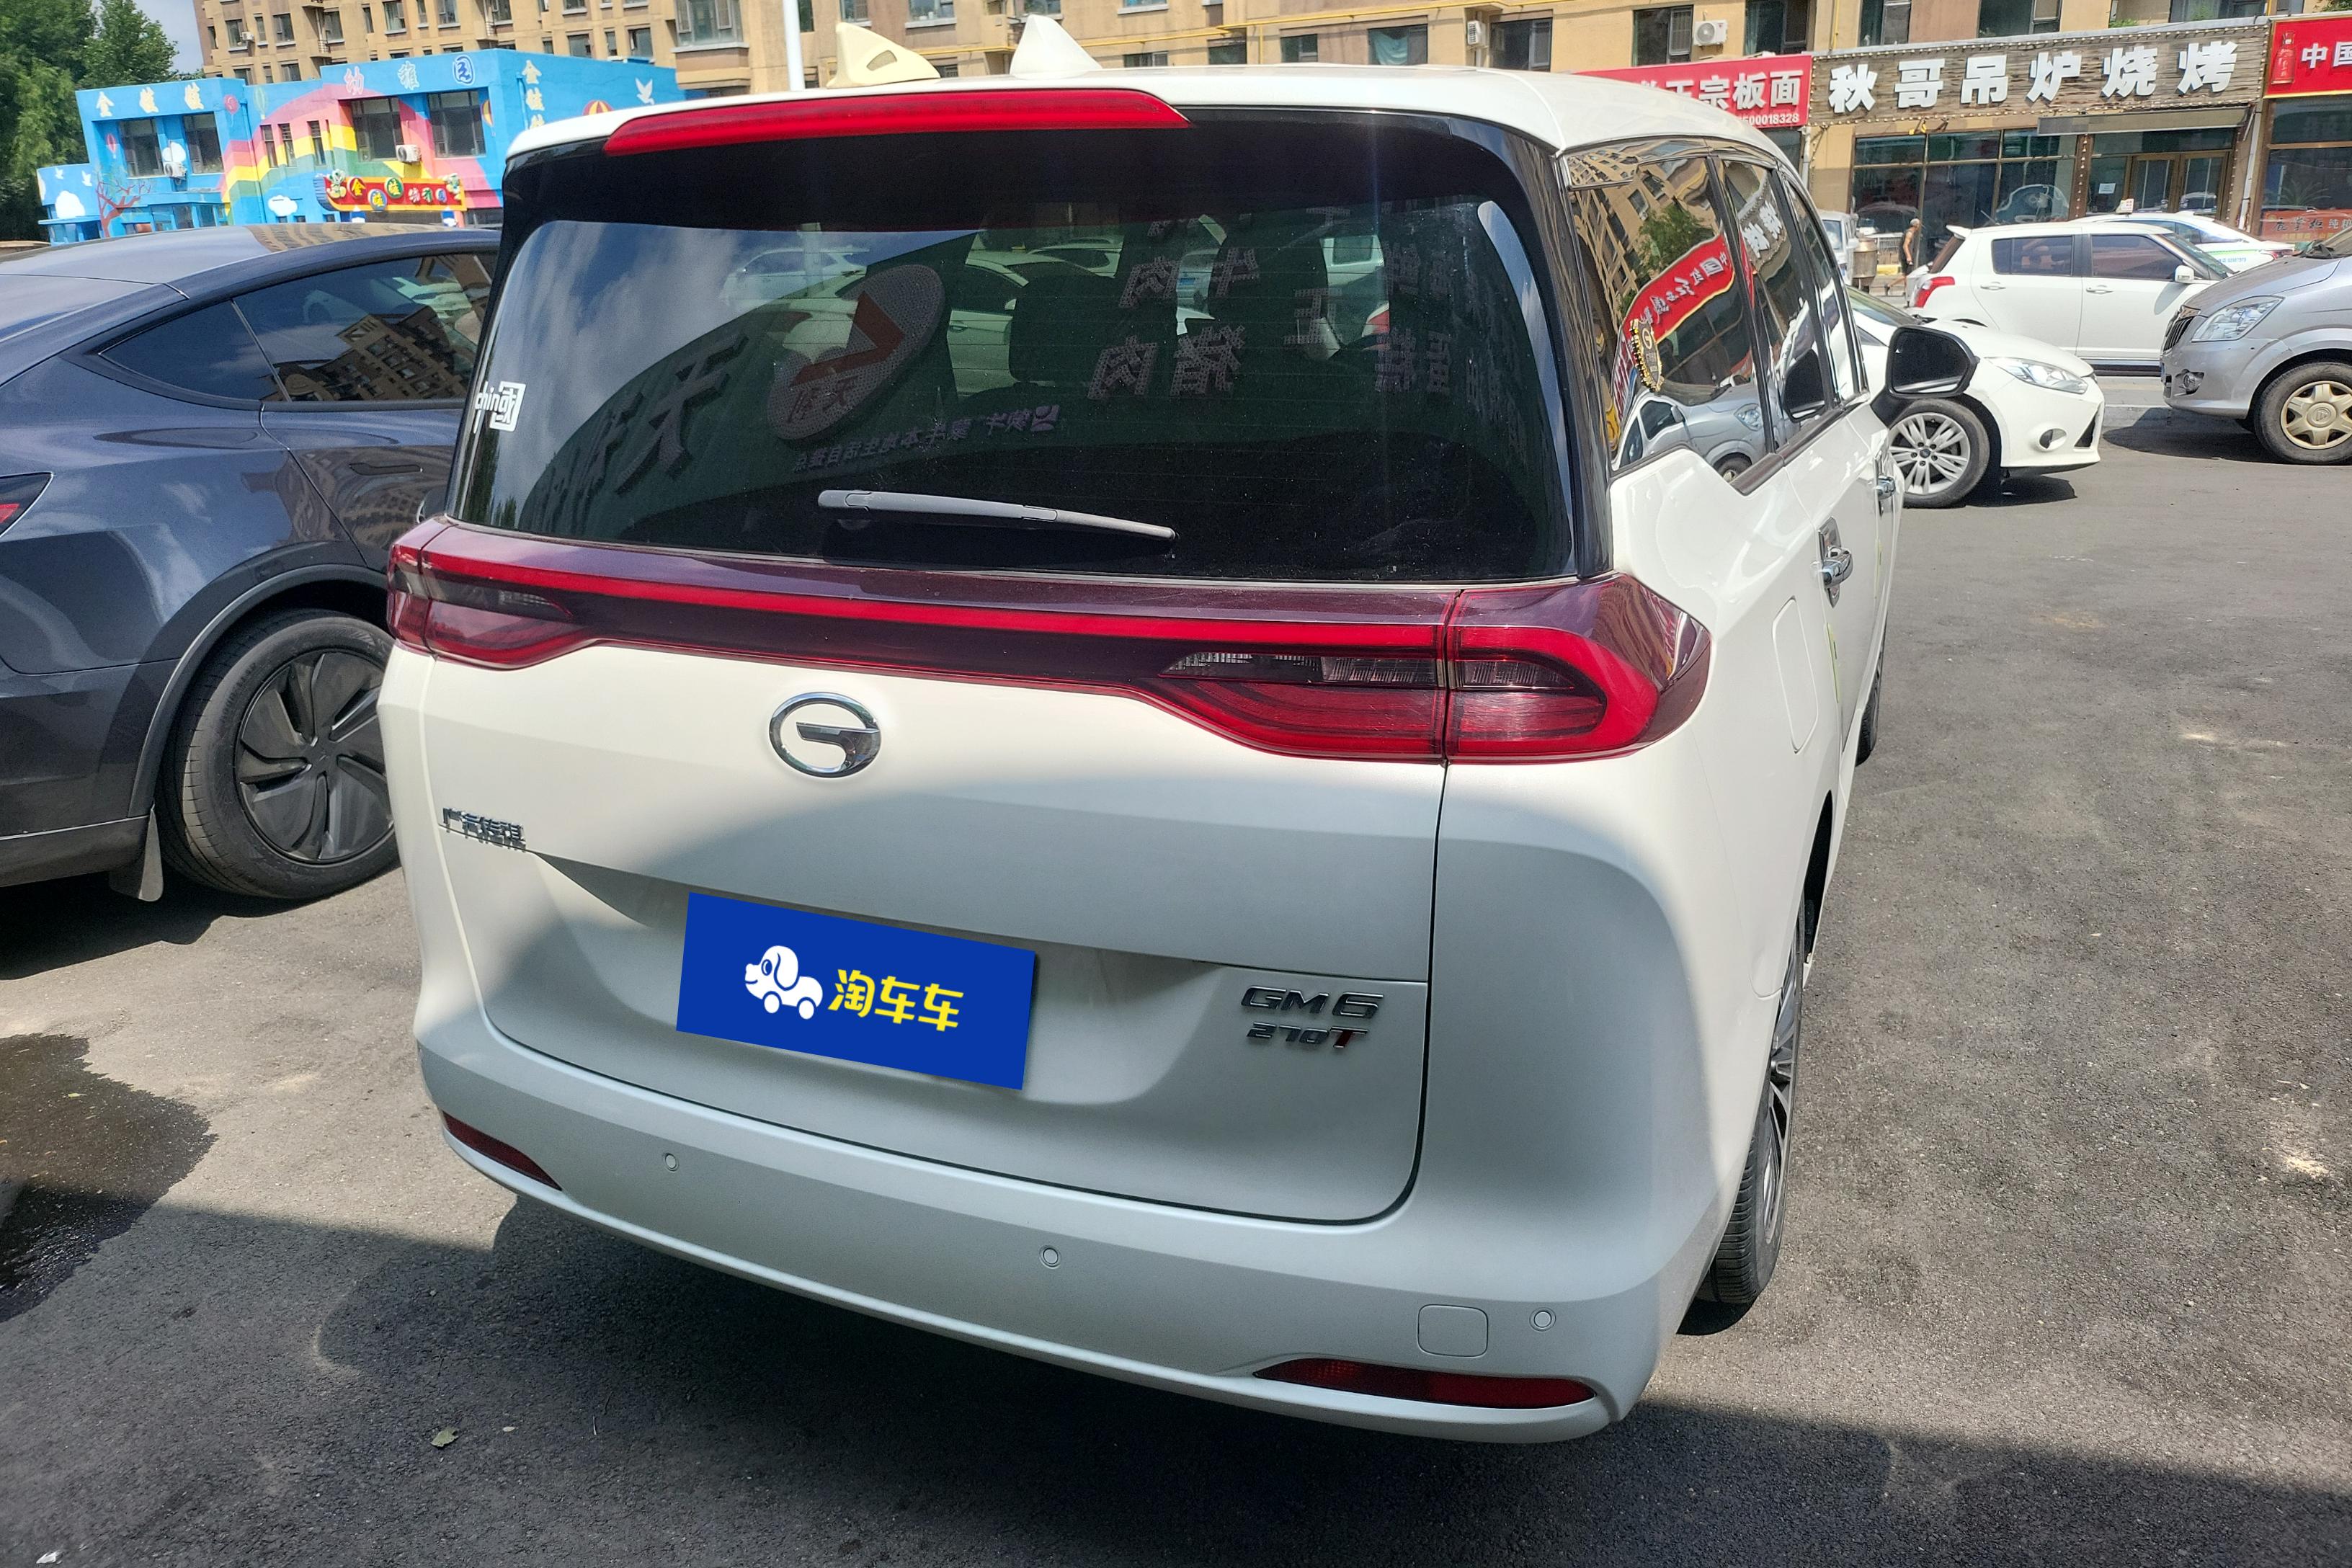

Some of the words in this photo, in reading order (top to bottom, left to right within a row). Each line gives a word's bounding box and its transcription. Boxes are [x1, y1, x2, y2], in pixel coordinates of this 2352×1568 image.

[1829, 40, 2239, 114] 秋哥吊炉烧烤
[1247, 1021, 1368, 1048] 270T
